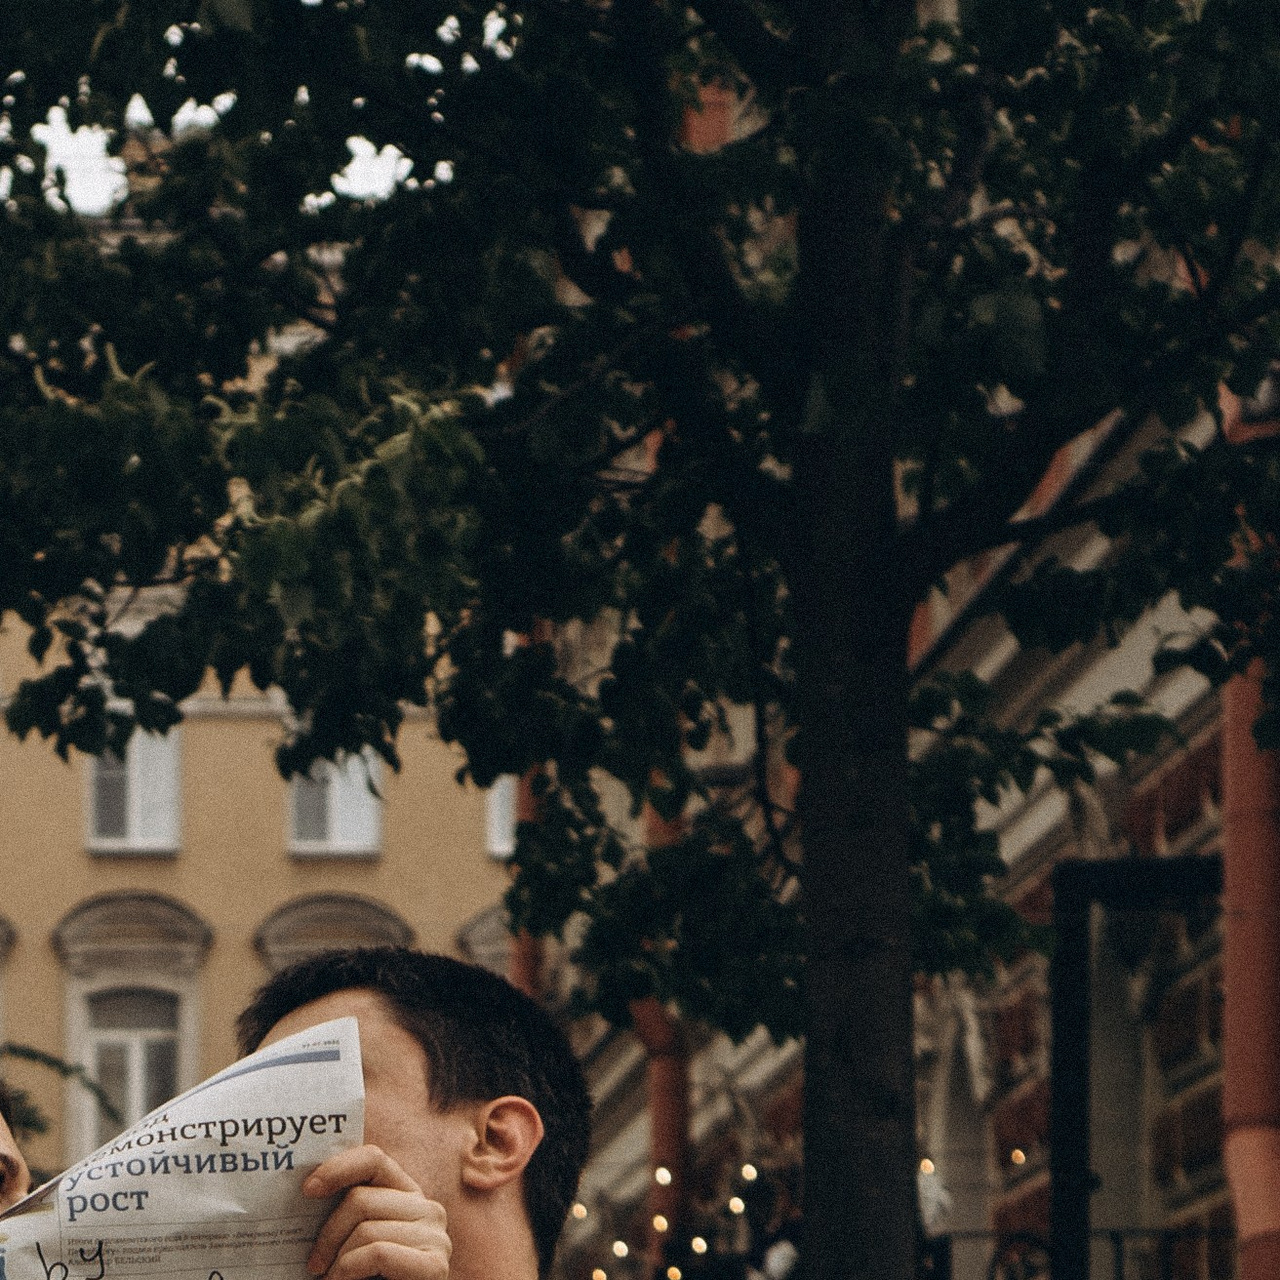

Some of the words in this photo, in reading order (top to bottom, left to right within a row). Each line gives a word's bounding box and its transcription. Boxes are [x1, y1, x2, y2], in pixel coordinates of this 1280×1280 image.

[75, 1112, 347, 1168] монстрирует
[65, 1142, 295, 1192] устойчивый
[66, 1189, 150, 1222] рост
